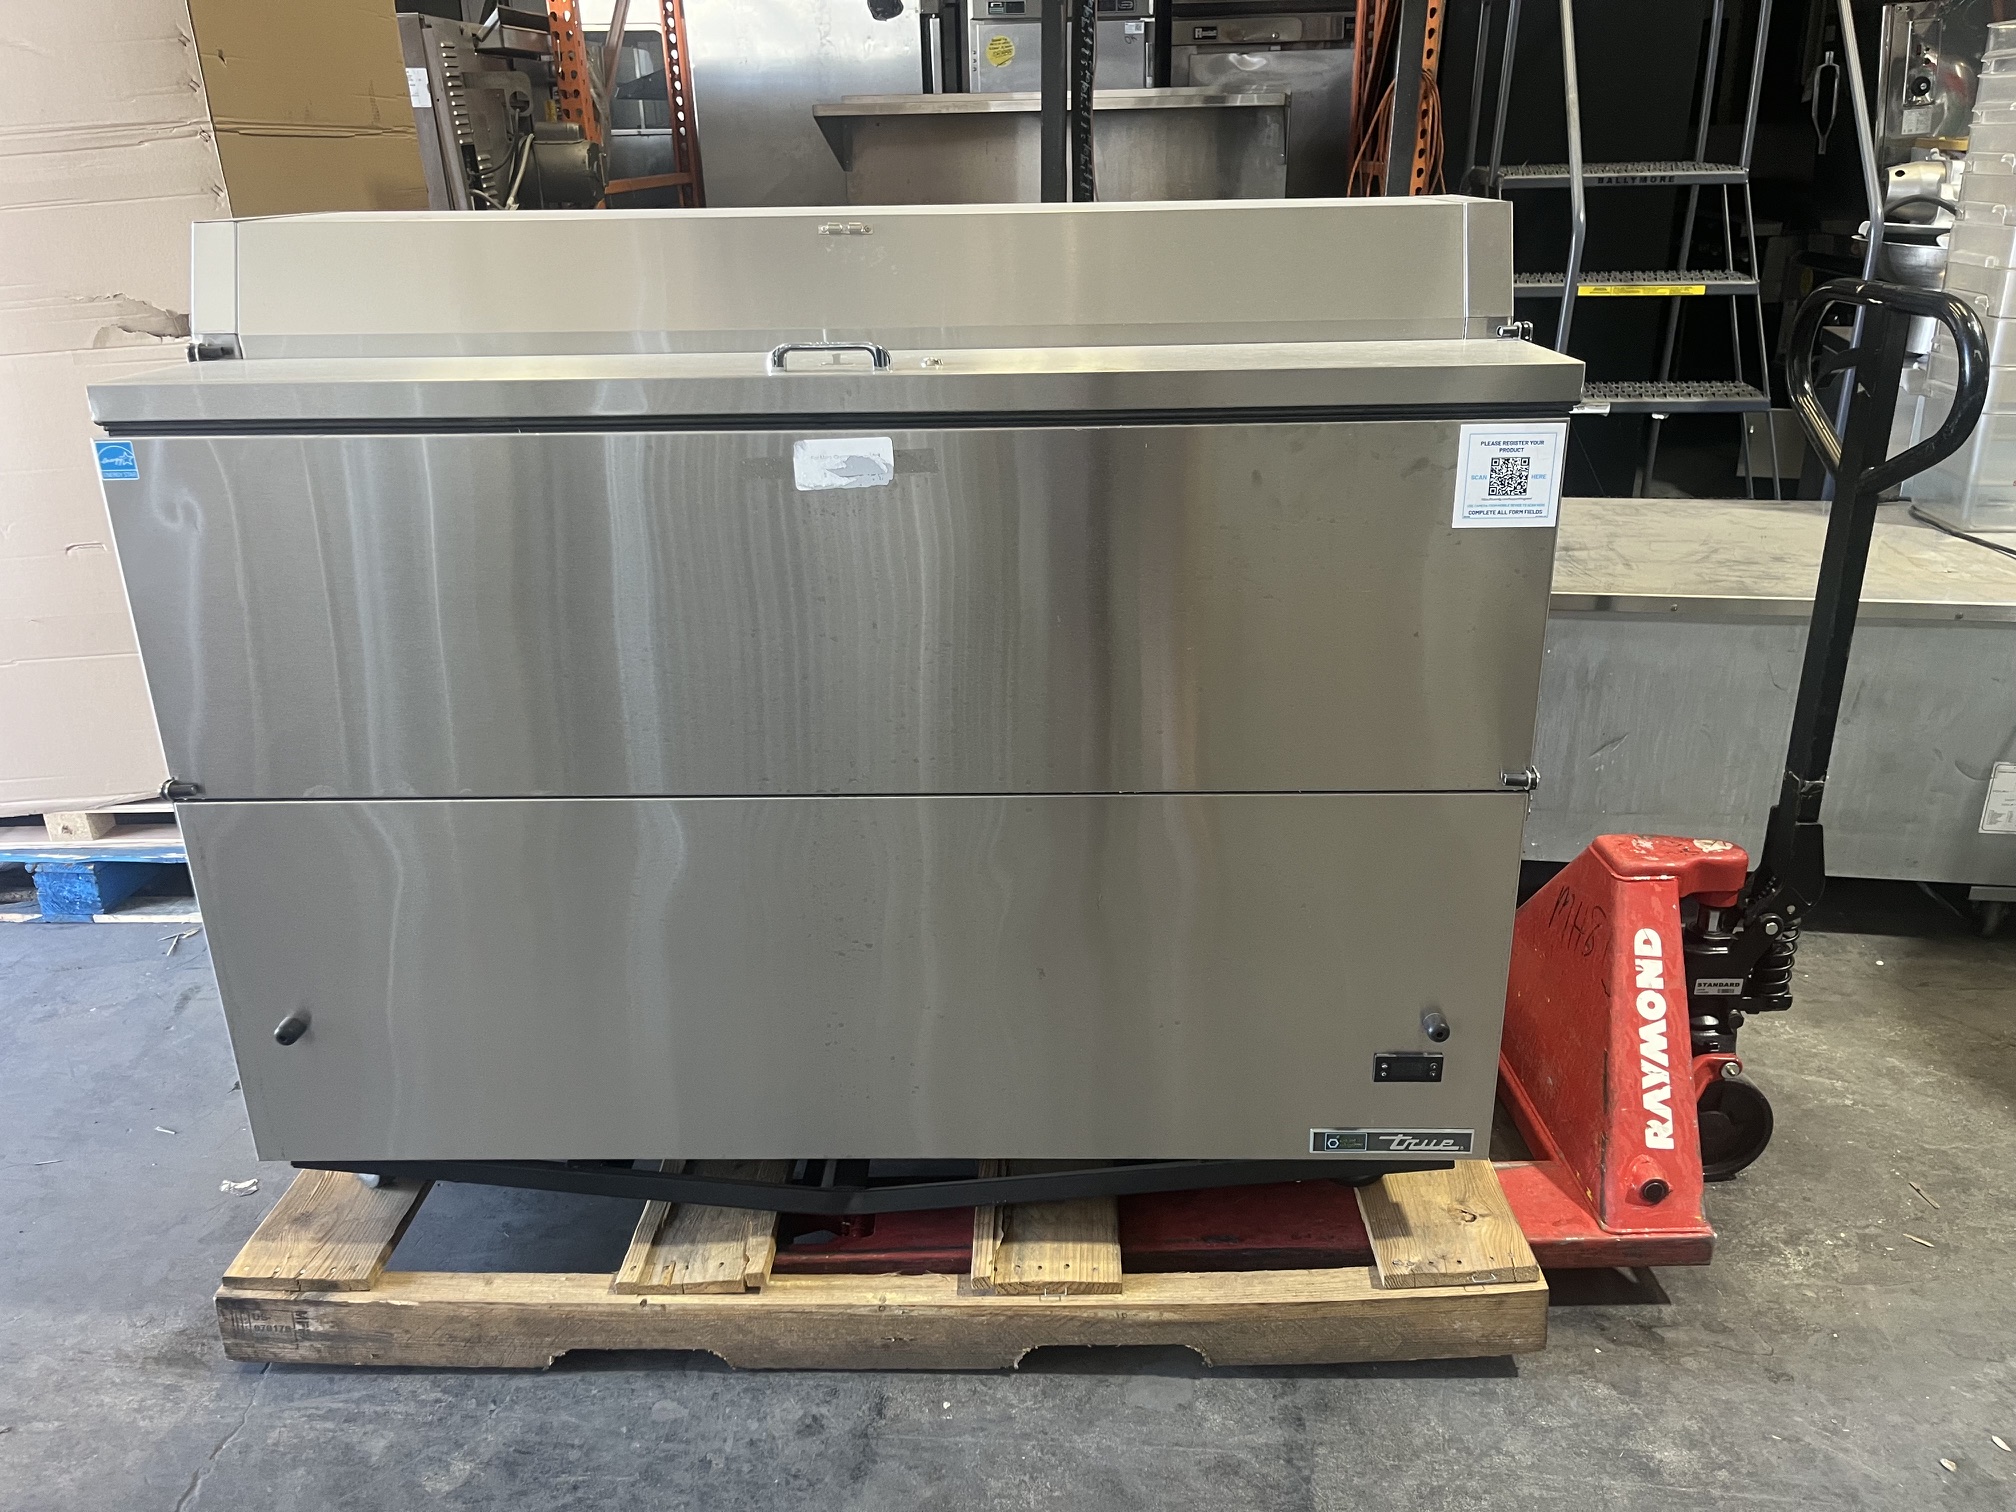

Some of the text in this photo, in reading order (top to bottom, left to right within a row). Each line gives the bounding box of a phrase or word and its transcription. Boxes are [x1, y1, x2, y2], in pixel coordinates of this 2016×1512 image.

[1597, 176, 1676, 184] BALLYMORE
[1633, 928, 1675, 1150] RAYMOND
[1378, 1134, 1460, 1150] true
